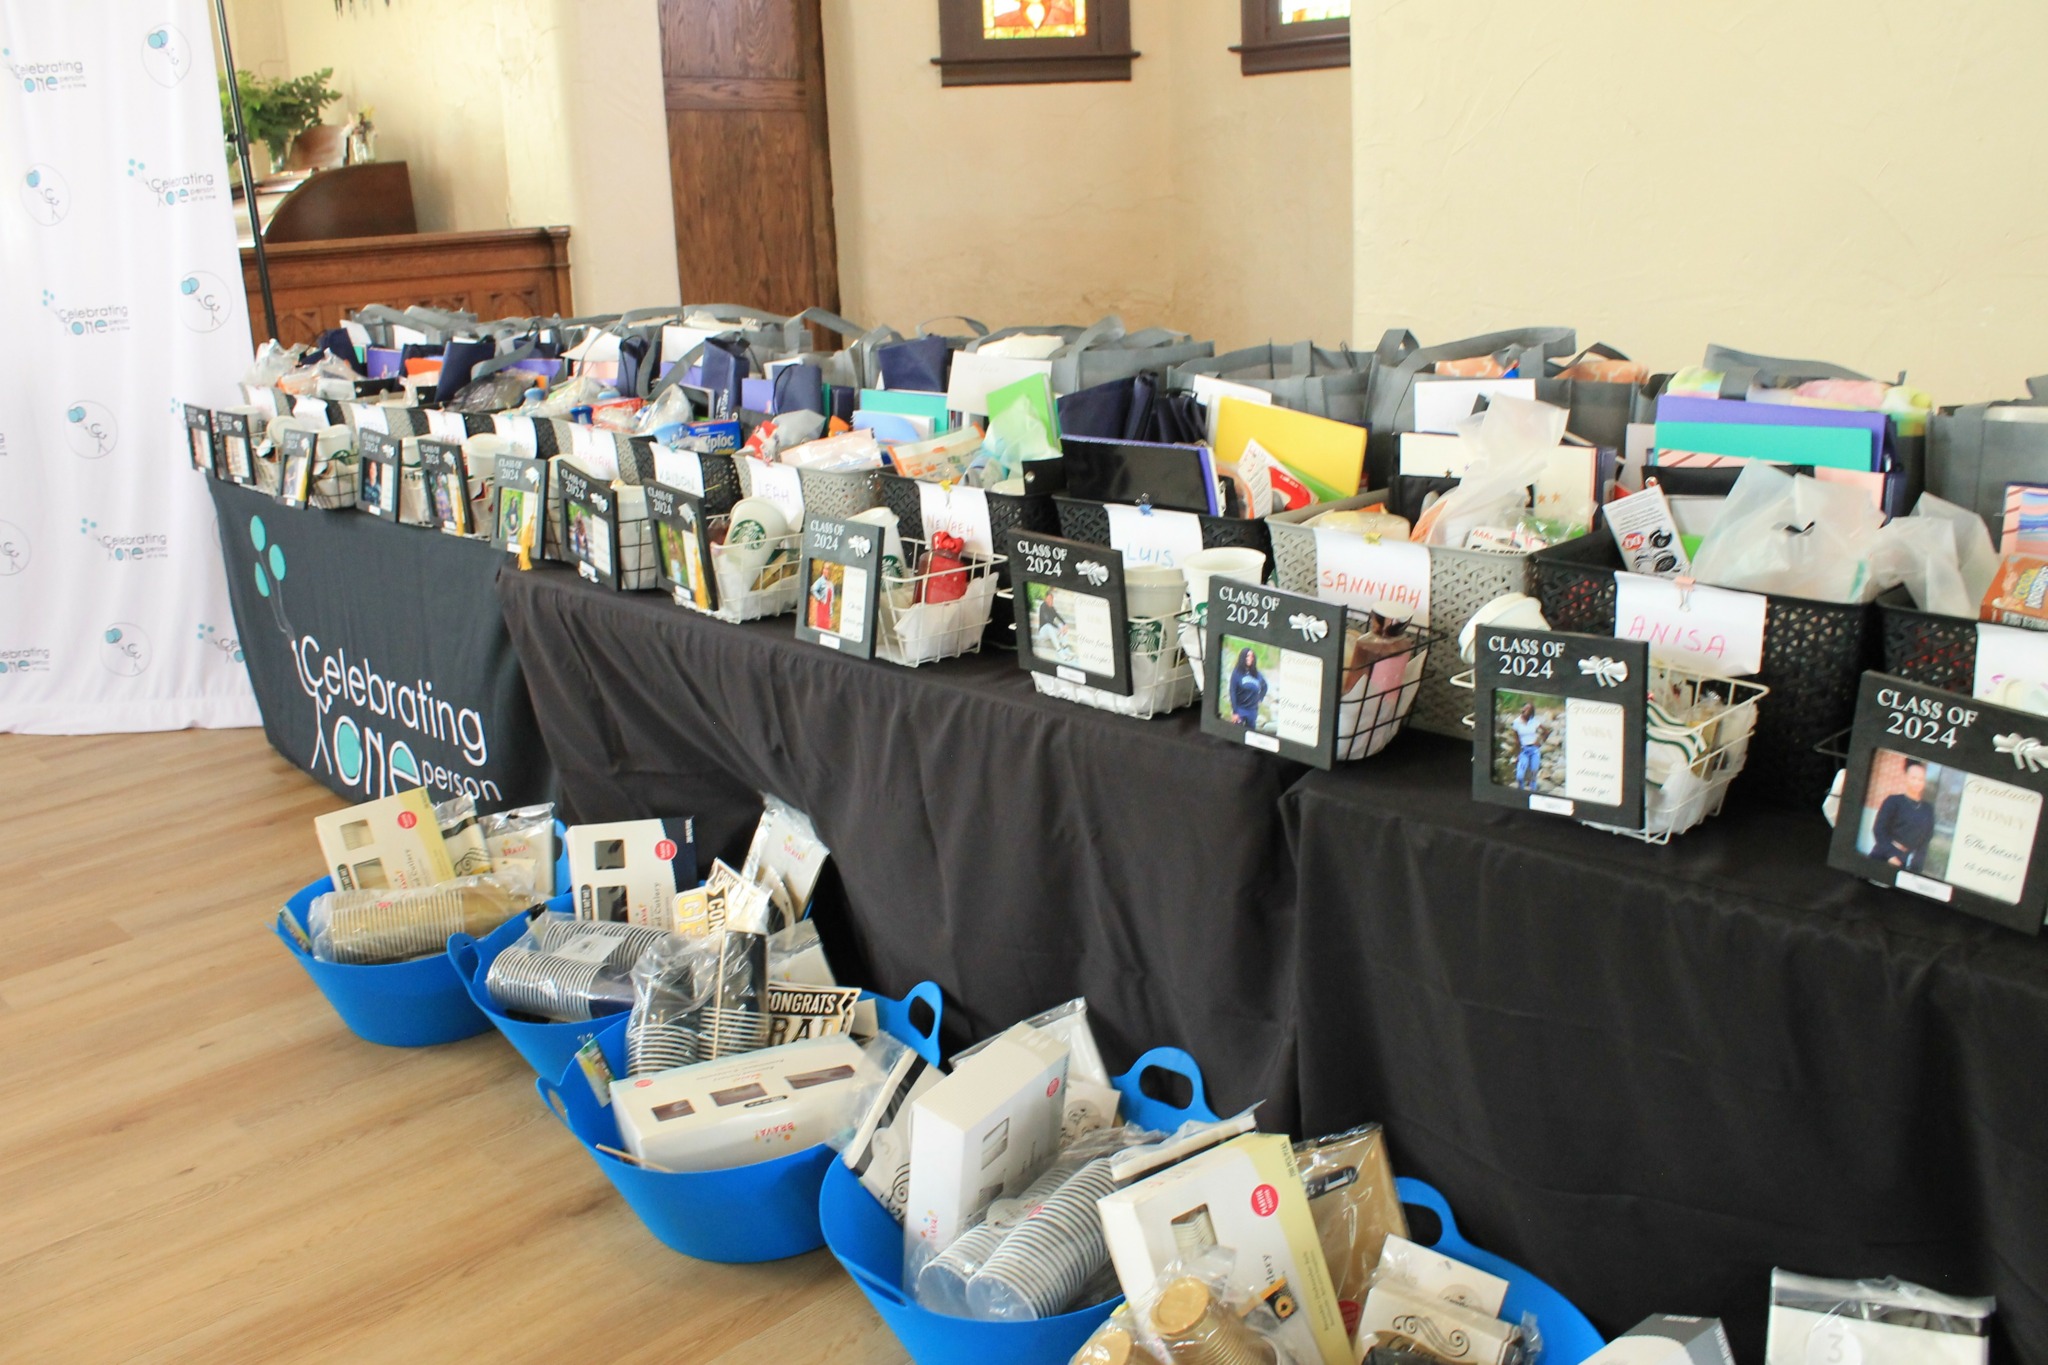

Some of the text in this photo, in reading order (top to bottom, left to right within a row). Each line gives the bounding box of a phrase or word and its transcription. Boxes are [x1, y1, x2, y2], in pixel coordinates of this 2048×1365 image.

[810, 520, 845, 537] CLASS OF
[813, 534, 839, 551] 2024
[1017, 540, 1068, 560] CLASS OF
[1026, 556, 1062, 577] 2024
[1125, 543, 1175, 569] LUIS
[1219, 586, 1280, 611] CLASS OF
[1320, 570, 1422, 610] SANNYIAH
[1226, 603, 1270, 629] 2024
[1488, 635, 1565, 658] CLASS OF
[1628, 615, 1727, 660] ANISA
[1499, 655, 1553, 679] 2024
[300, 635, 488, 767] Celebrating
[1876, 688, 1978, 728] CLASS OF
[1886, 711, 1957, 749] 2024
[421, 759, 503, 802] person
[768, 993, 837, 1014] ONGRATS
[1826, 1333, 1845, 1363] 3
